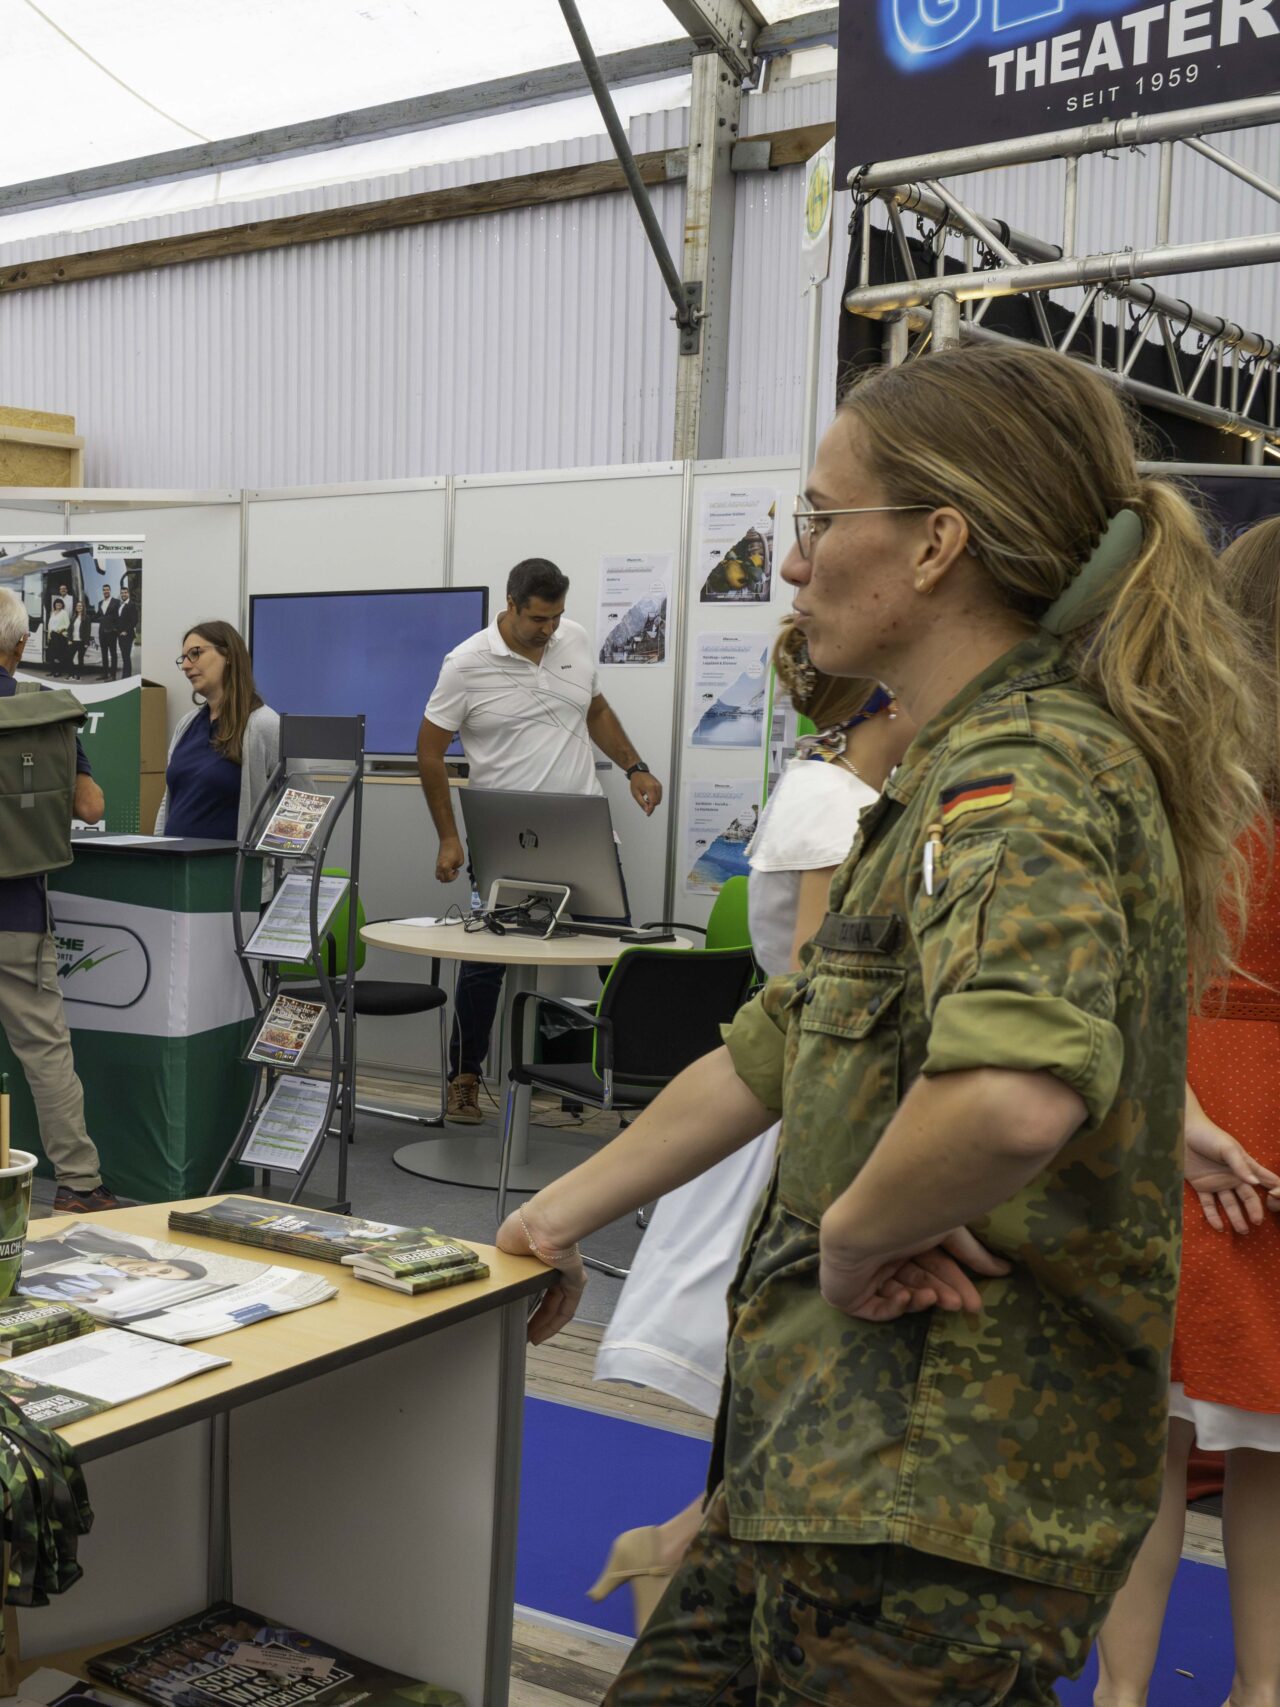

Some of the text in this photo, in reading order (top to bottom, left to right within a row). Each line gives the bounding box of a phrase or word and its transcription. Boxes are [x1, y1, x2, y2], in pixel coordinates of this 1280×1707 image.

[989, 0, 1280, 96] THEATER
[1066, 63, 1199, 112] SEIT 1959
